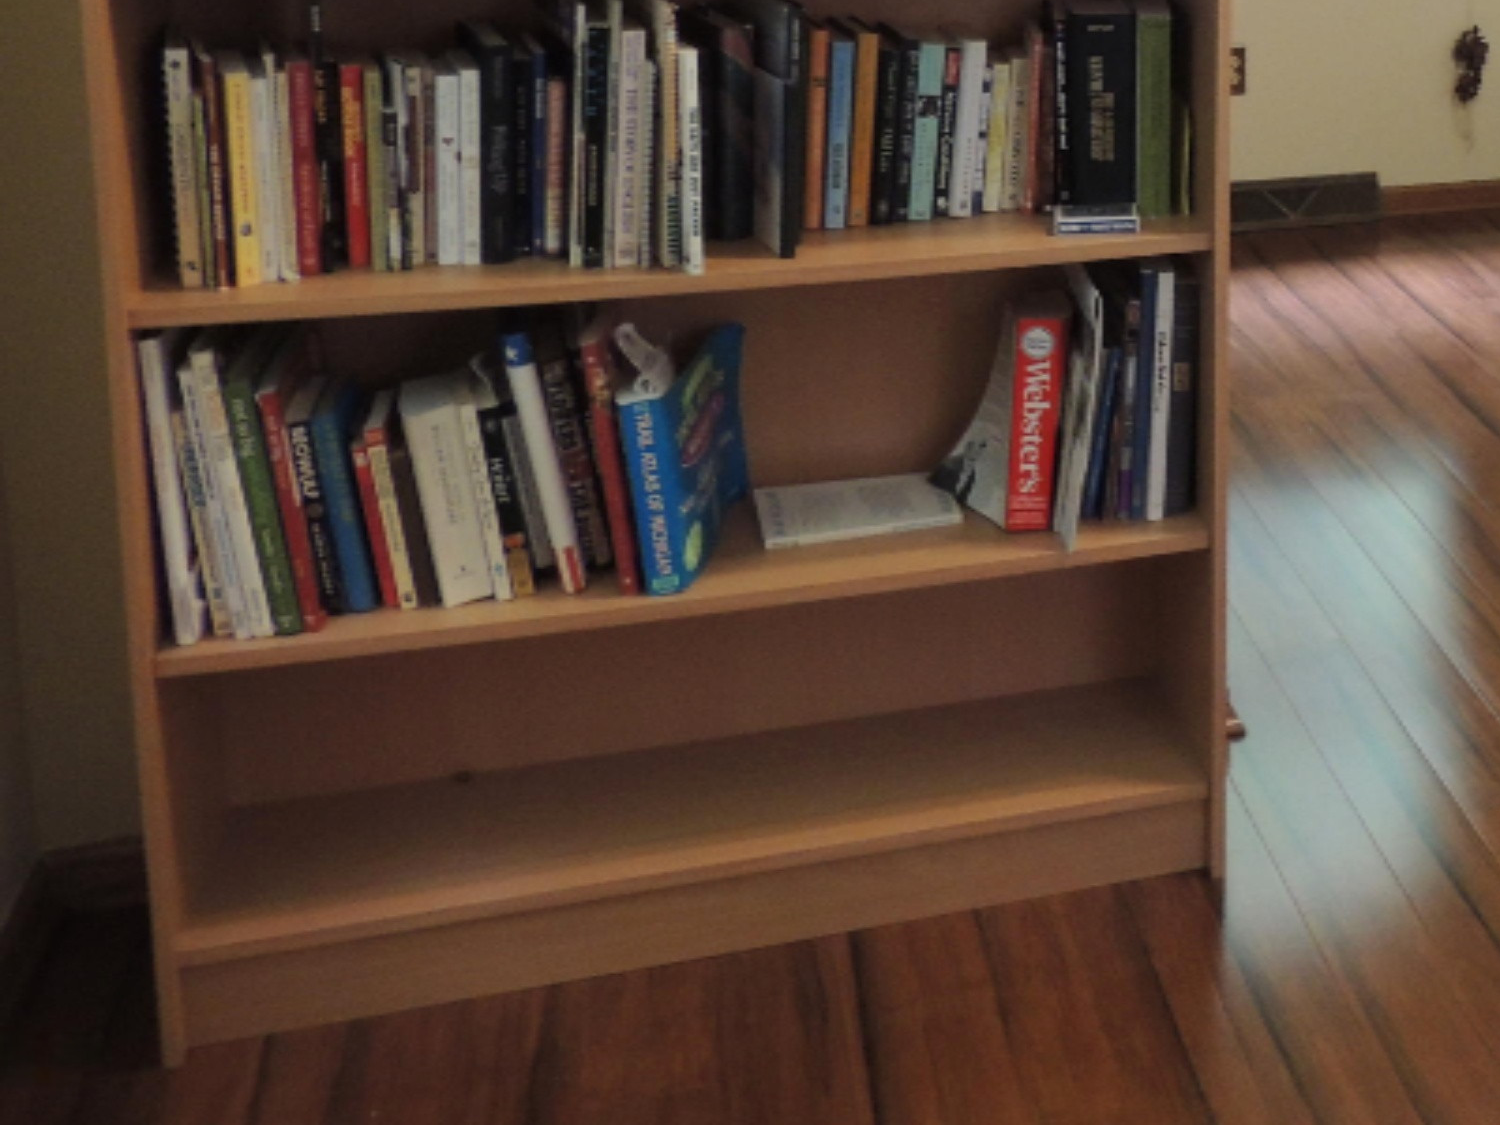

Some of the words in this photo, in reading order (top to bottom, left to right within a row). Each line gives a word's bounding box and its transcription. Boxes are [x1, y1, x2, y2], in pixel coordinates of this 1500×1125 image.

[633, 412, 653, 450] TRAIL
[1017, 359, 1052, 494] Webster's
[640, 451, 659, 492] ATLAS
[647, 493, 664, 511] OF
[649, 514, 673, 576] MICHIGAN
